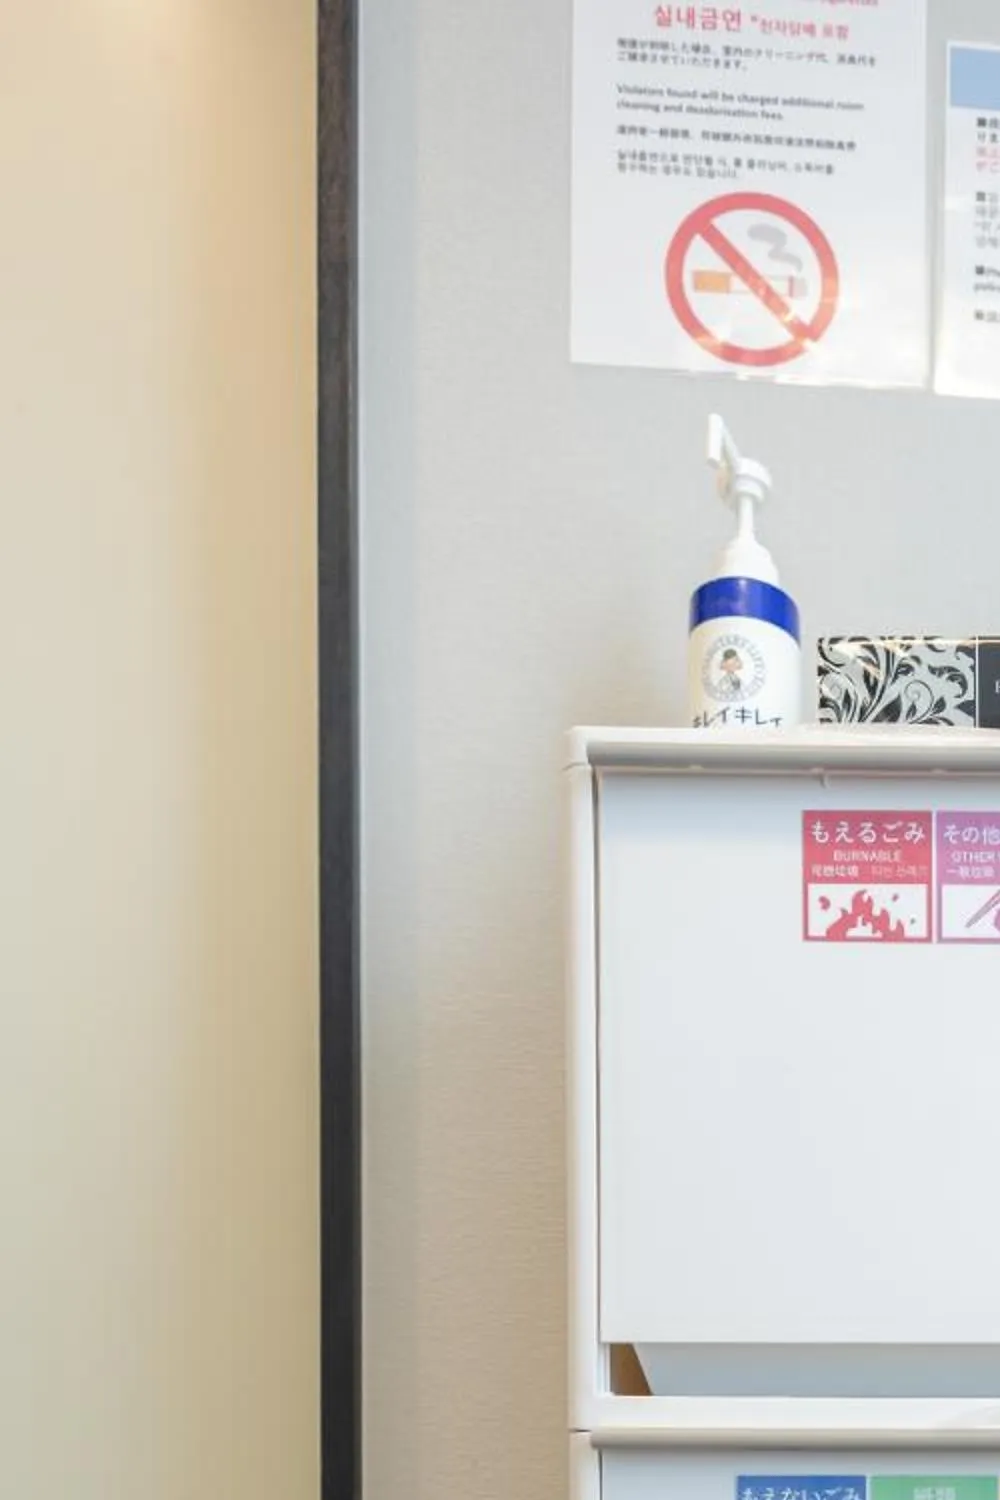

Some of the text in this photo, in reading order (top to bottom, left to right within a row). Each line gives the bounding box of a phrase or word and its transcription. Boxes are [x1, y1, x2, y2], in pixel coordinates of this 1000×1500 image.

[655, 4, 741, 32] 실내금연
[811, 820, 926, 844] もえるごみ
[833, 850, 902, 862] BURNABLE
[951, 851, 996, 863] OTHER
